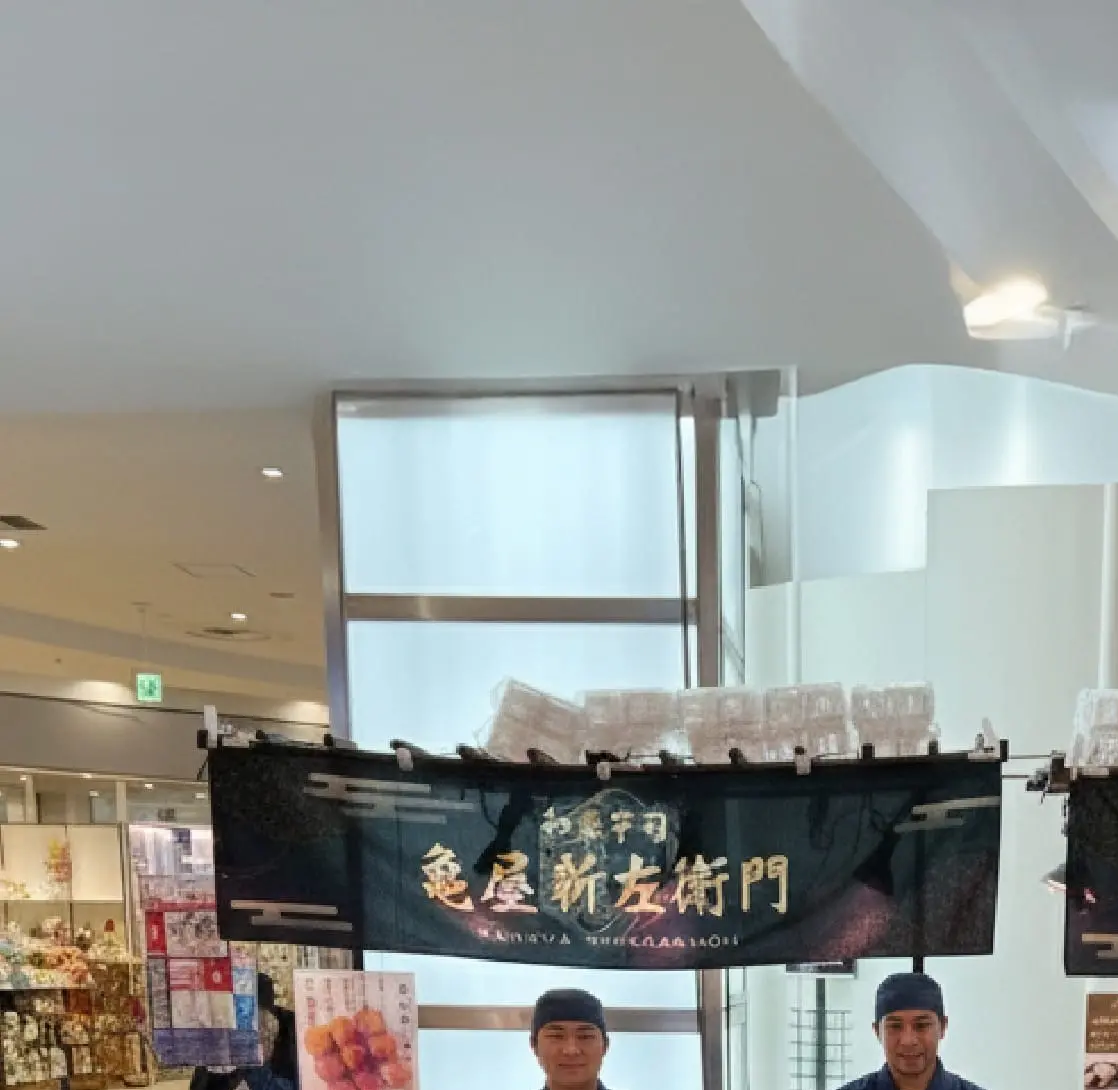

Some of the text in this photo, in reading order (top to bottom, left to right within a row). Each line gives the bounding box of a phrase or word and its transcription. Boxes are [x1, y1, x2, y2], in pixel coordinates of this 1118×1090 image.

[420, 841, 790, 917] 亀屋新左衛門
